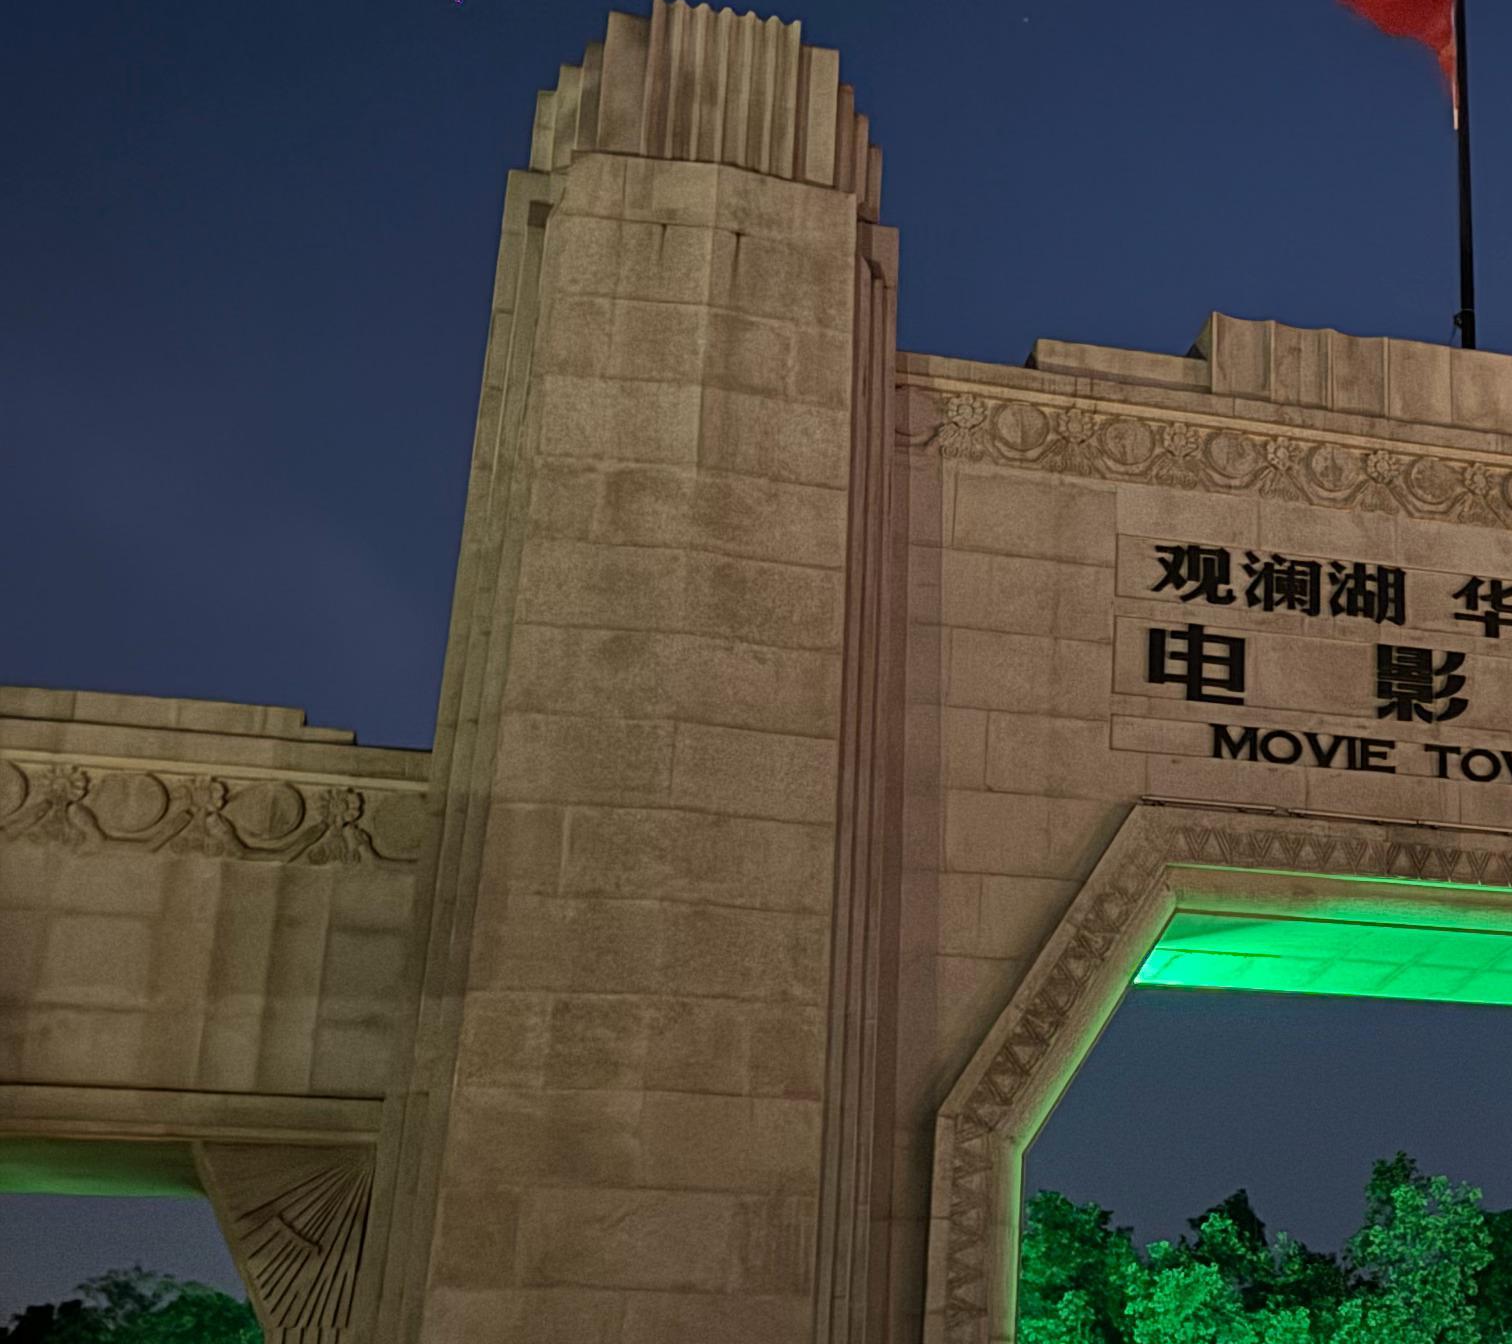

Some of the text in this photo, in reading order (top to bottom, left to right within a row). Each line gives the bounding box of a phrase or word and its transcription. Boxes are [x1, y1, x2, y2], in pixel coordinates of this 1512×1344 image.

[1151, 544, 1406, 626] 观澜湖
[1208, 723, 1396, 774] MOVIE
